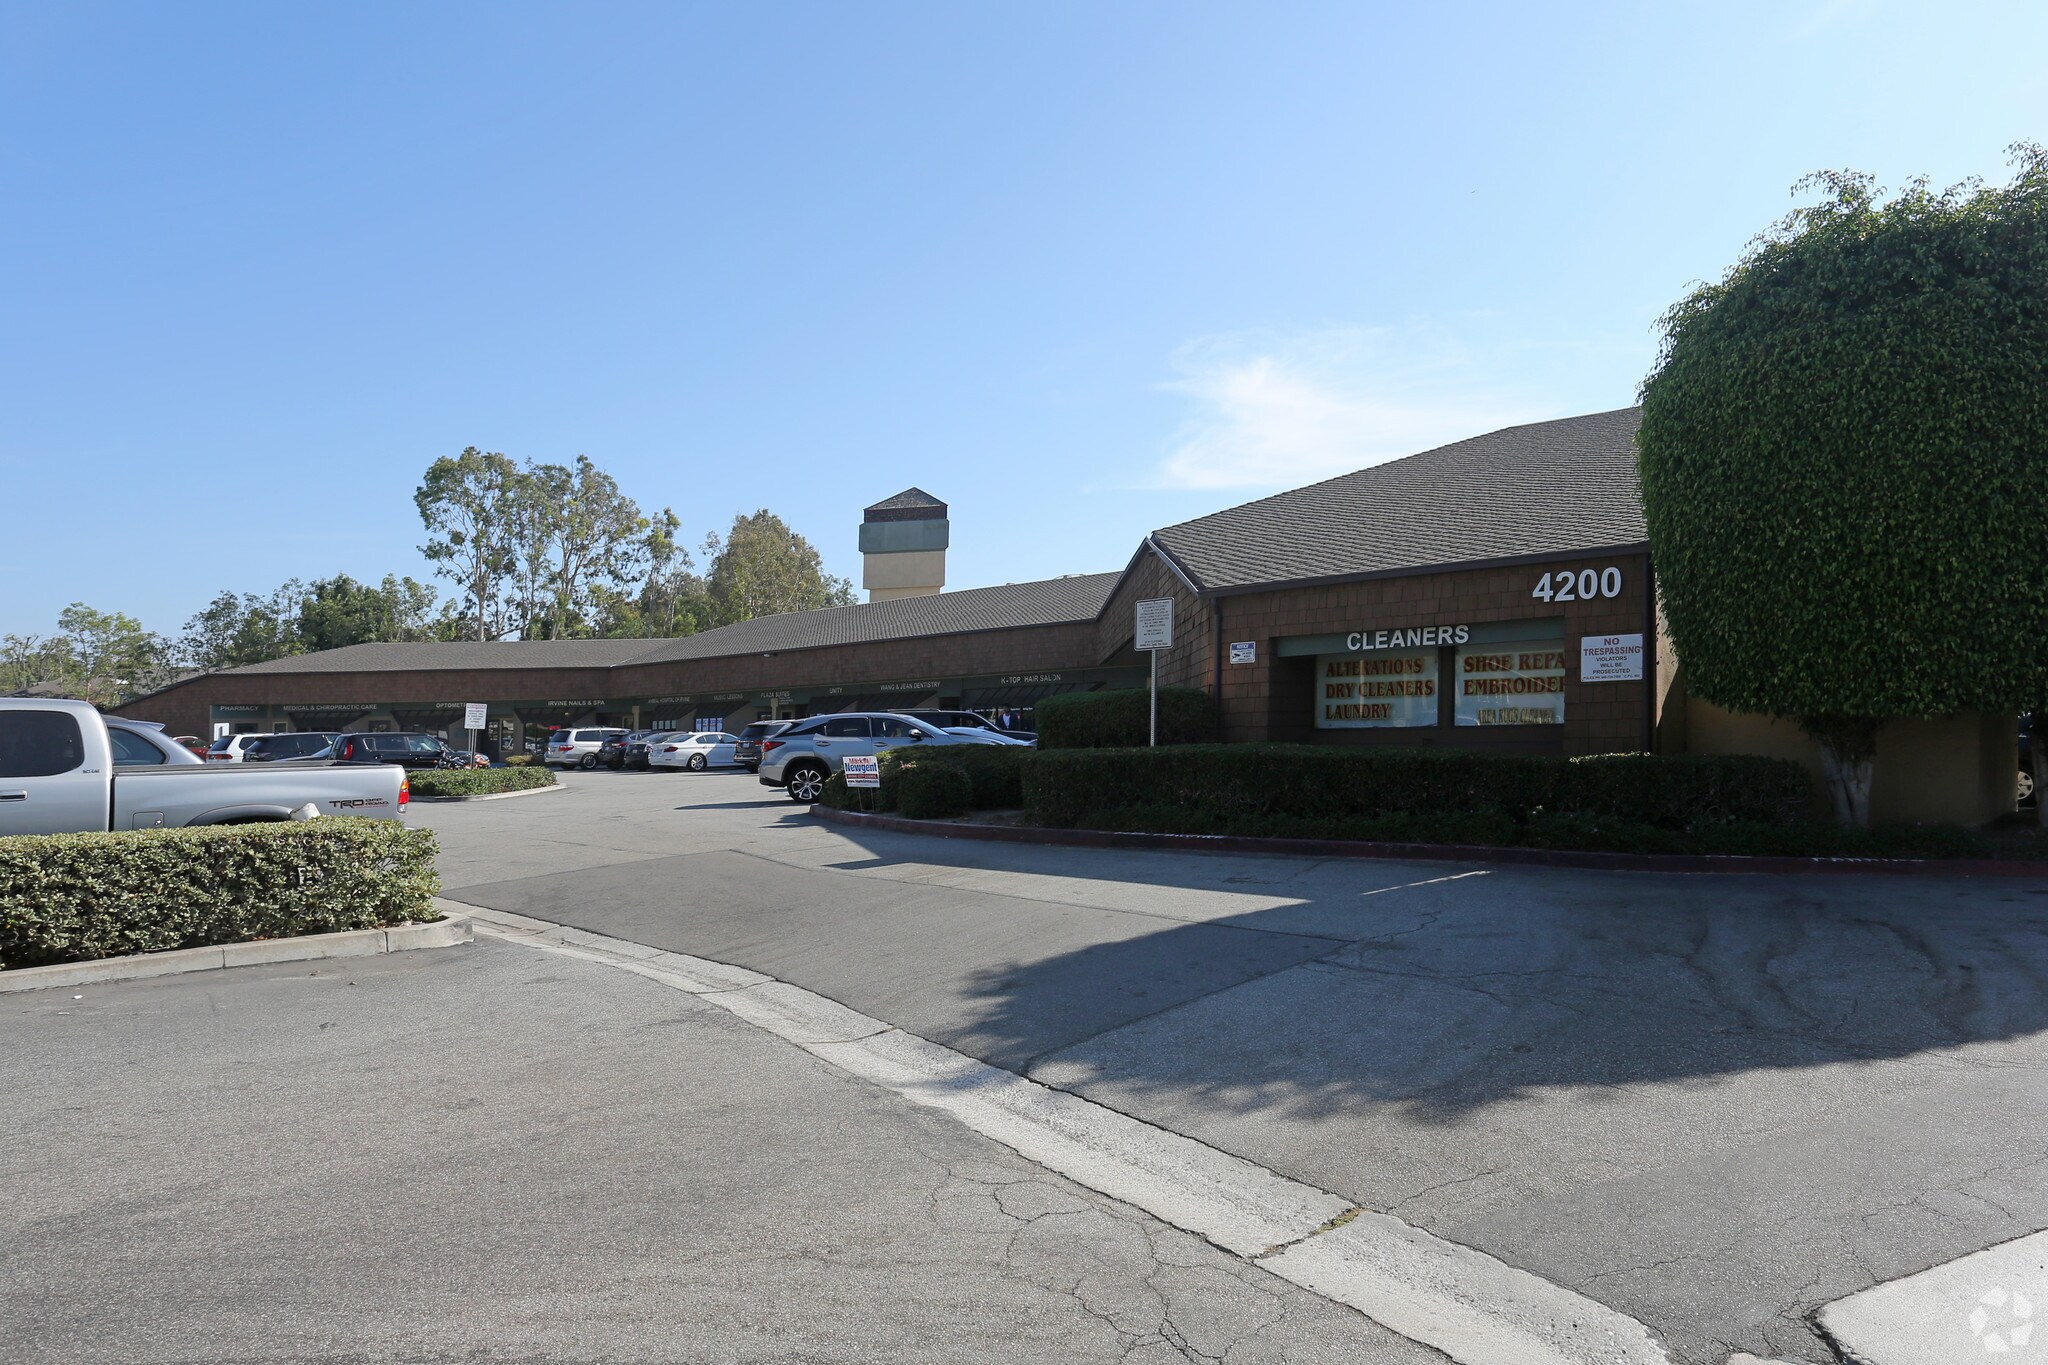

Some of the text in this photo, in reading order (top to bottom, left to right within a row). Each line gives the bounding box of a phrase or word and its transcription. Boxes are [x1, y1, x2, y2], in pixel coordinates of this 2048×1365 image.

[1532, 567, 1621, 602] 4200
[1347, 625, 1469, 650] CLEANERS
[1583, 646, 1640, 656] TRESPASSING
[1326, 659, 1424, 677] ALTERATIONS
[1464, 654, 1512, 673] SHOE
[1326, 680, 1434, 698] DRY CLEANERS
[1326, 703, 1390, 720] LAUNDRY
[845, 762, 877, 773] Newgent
[329, 800, 364, 809] TRD
